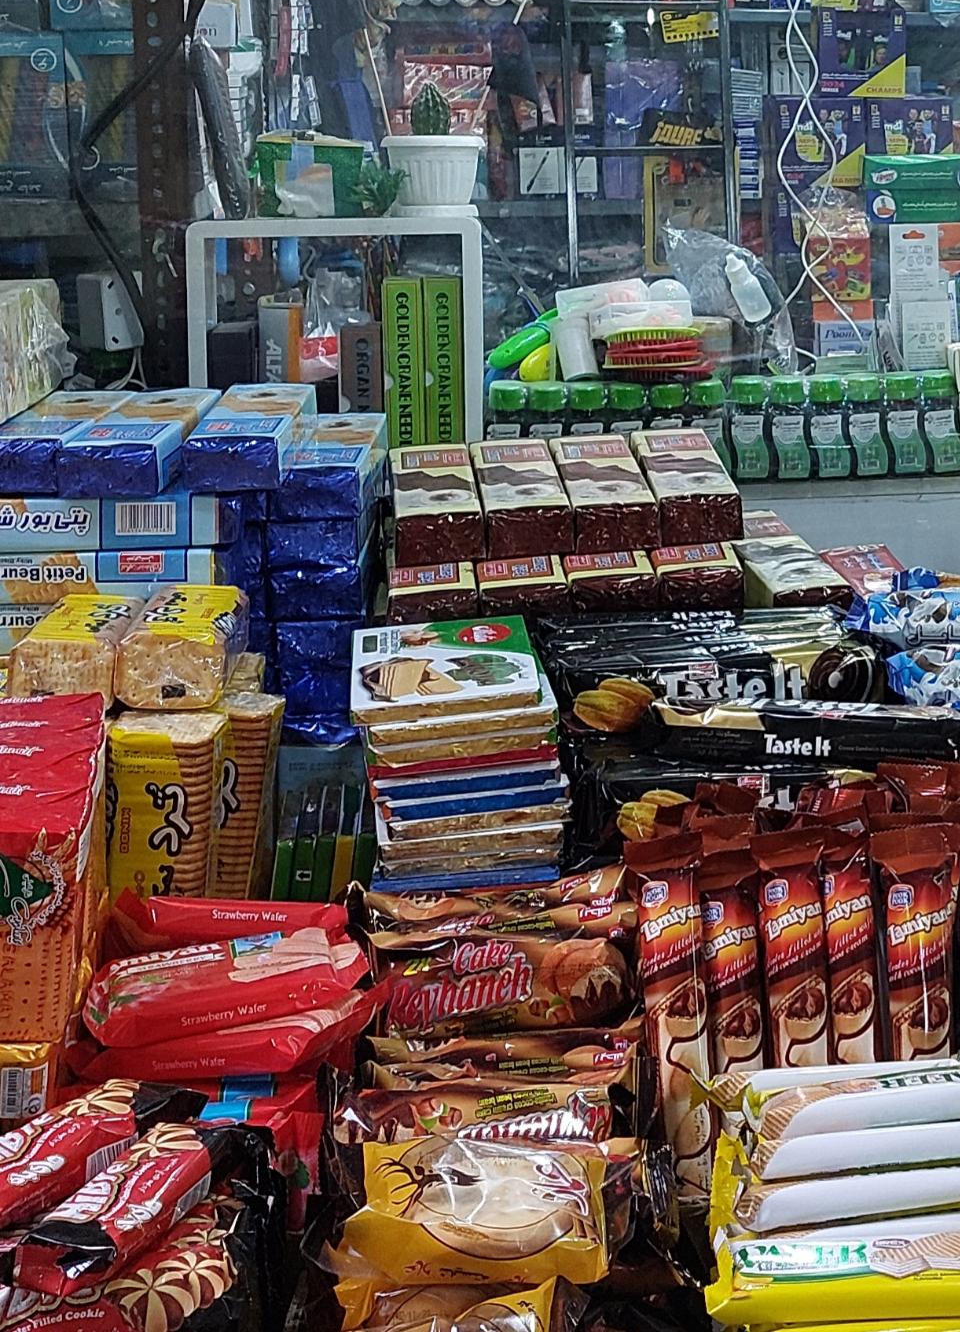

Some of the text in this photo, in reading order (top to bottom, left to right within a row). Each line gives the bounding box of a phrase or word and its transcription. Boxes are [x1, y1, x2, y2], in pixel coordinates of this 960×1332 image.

[866, 86, 903, 96] CHAMPS
[355, 337, 372, 401] ORGAN
[43, 565, 87, 581] Petit
[660, 672, 768, 701] Taste
[764, 733, 812, 755] Taste
[814, 735, 832, 757] It
[212, 908, 288, 924] Strawberry Wafer
[640, 902, 702, 942] Tamiyan
[765, 901, 823, 941] Tamiyan
[887, 906, 952, 946] Tamiyan
[453, 938, 514, 974] Cake
[181, 1002, 268, 1028] Strawberry Wafer
[64, 1306, 106, 1325] Cookie
